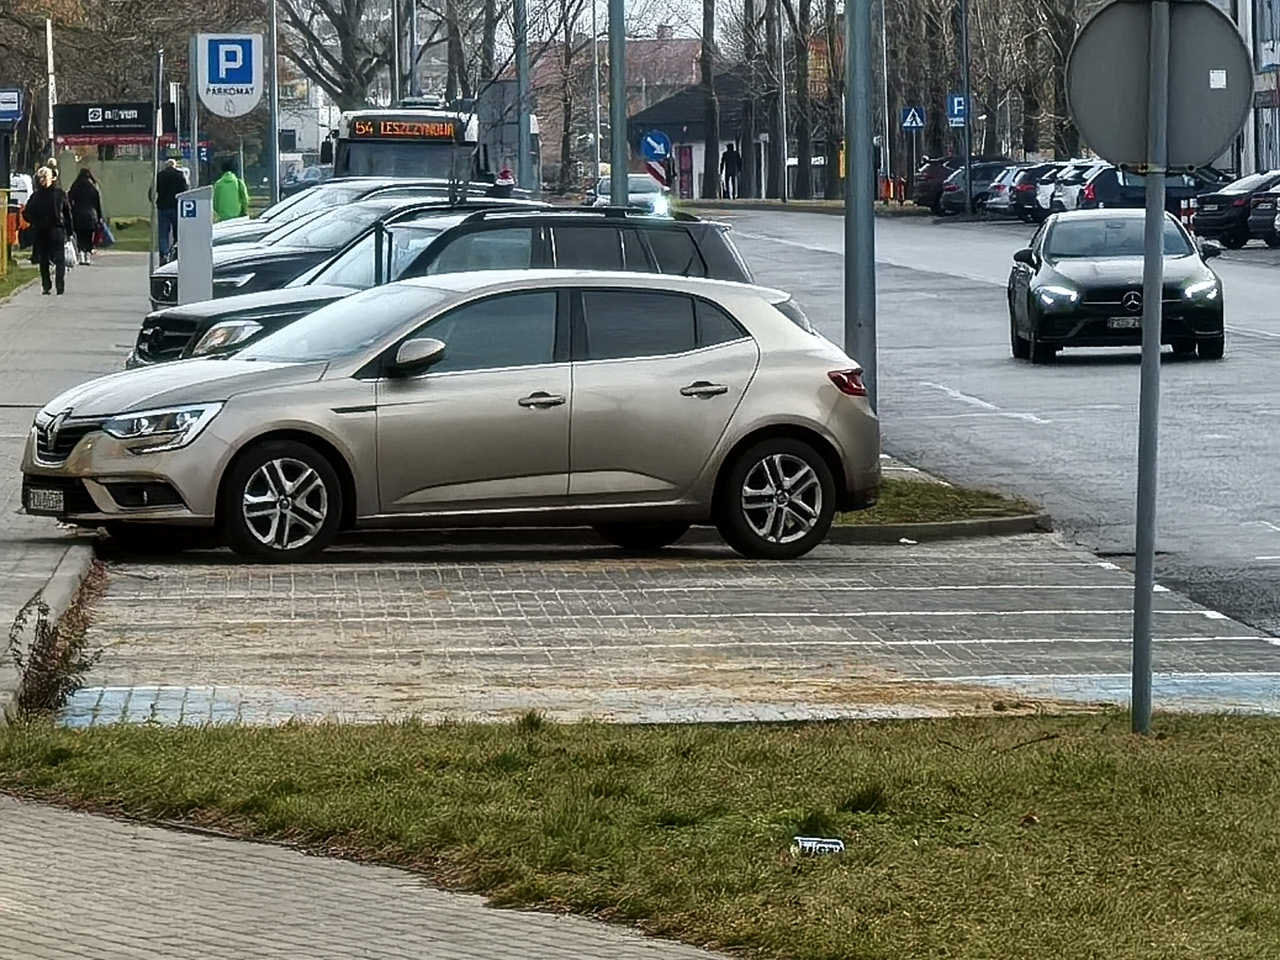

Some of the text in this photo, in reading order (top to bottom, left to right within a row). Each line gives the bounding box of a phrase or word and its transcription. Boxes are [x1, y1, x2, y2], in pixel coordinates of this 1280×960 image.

[218, 44, 243, 78] P
[206, 87, 255, 96] PARKOMAT
[953, 97, 965, 115] P
[183, 201, 195, 217] P
